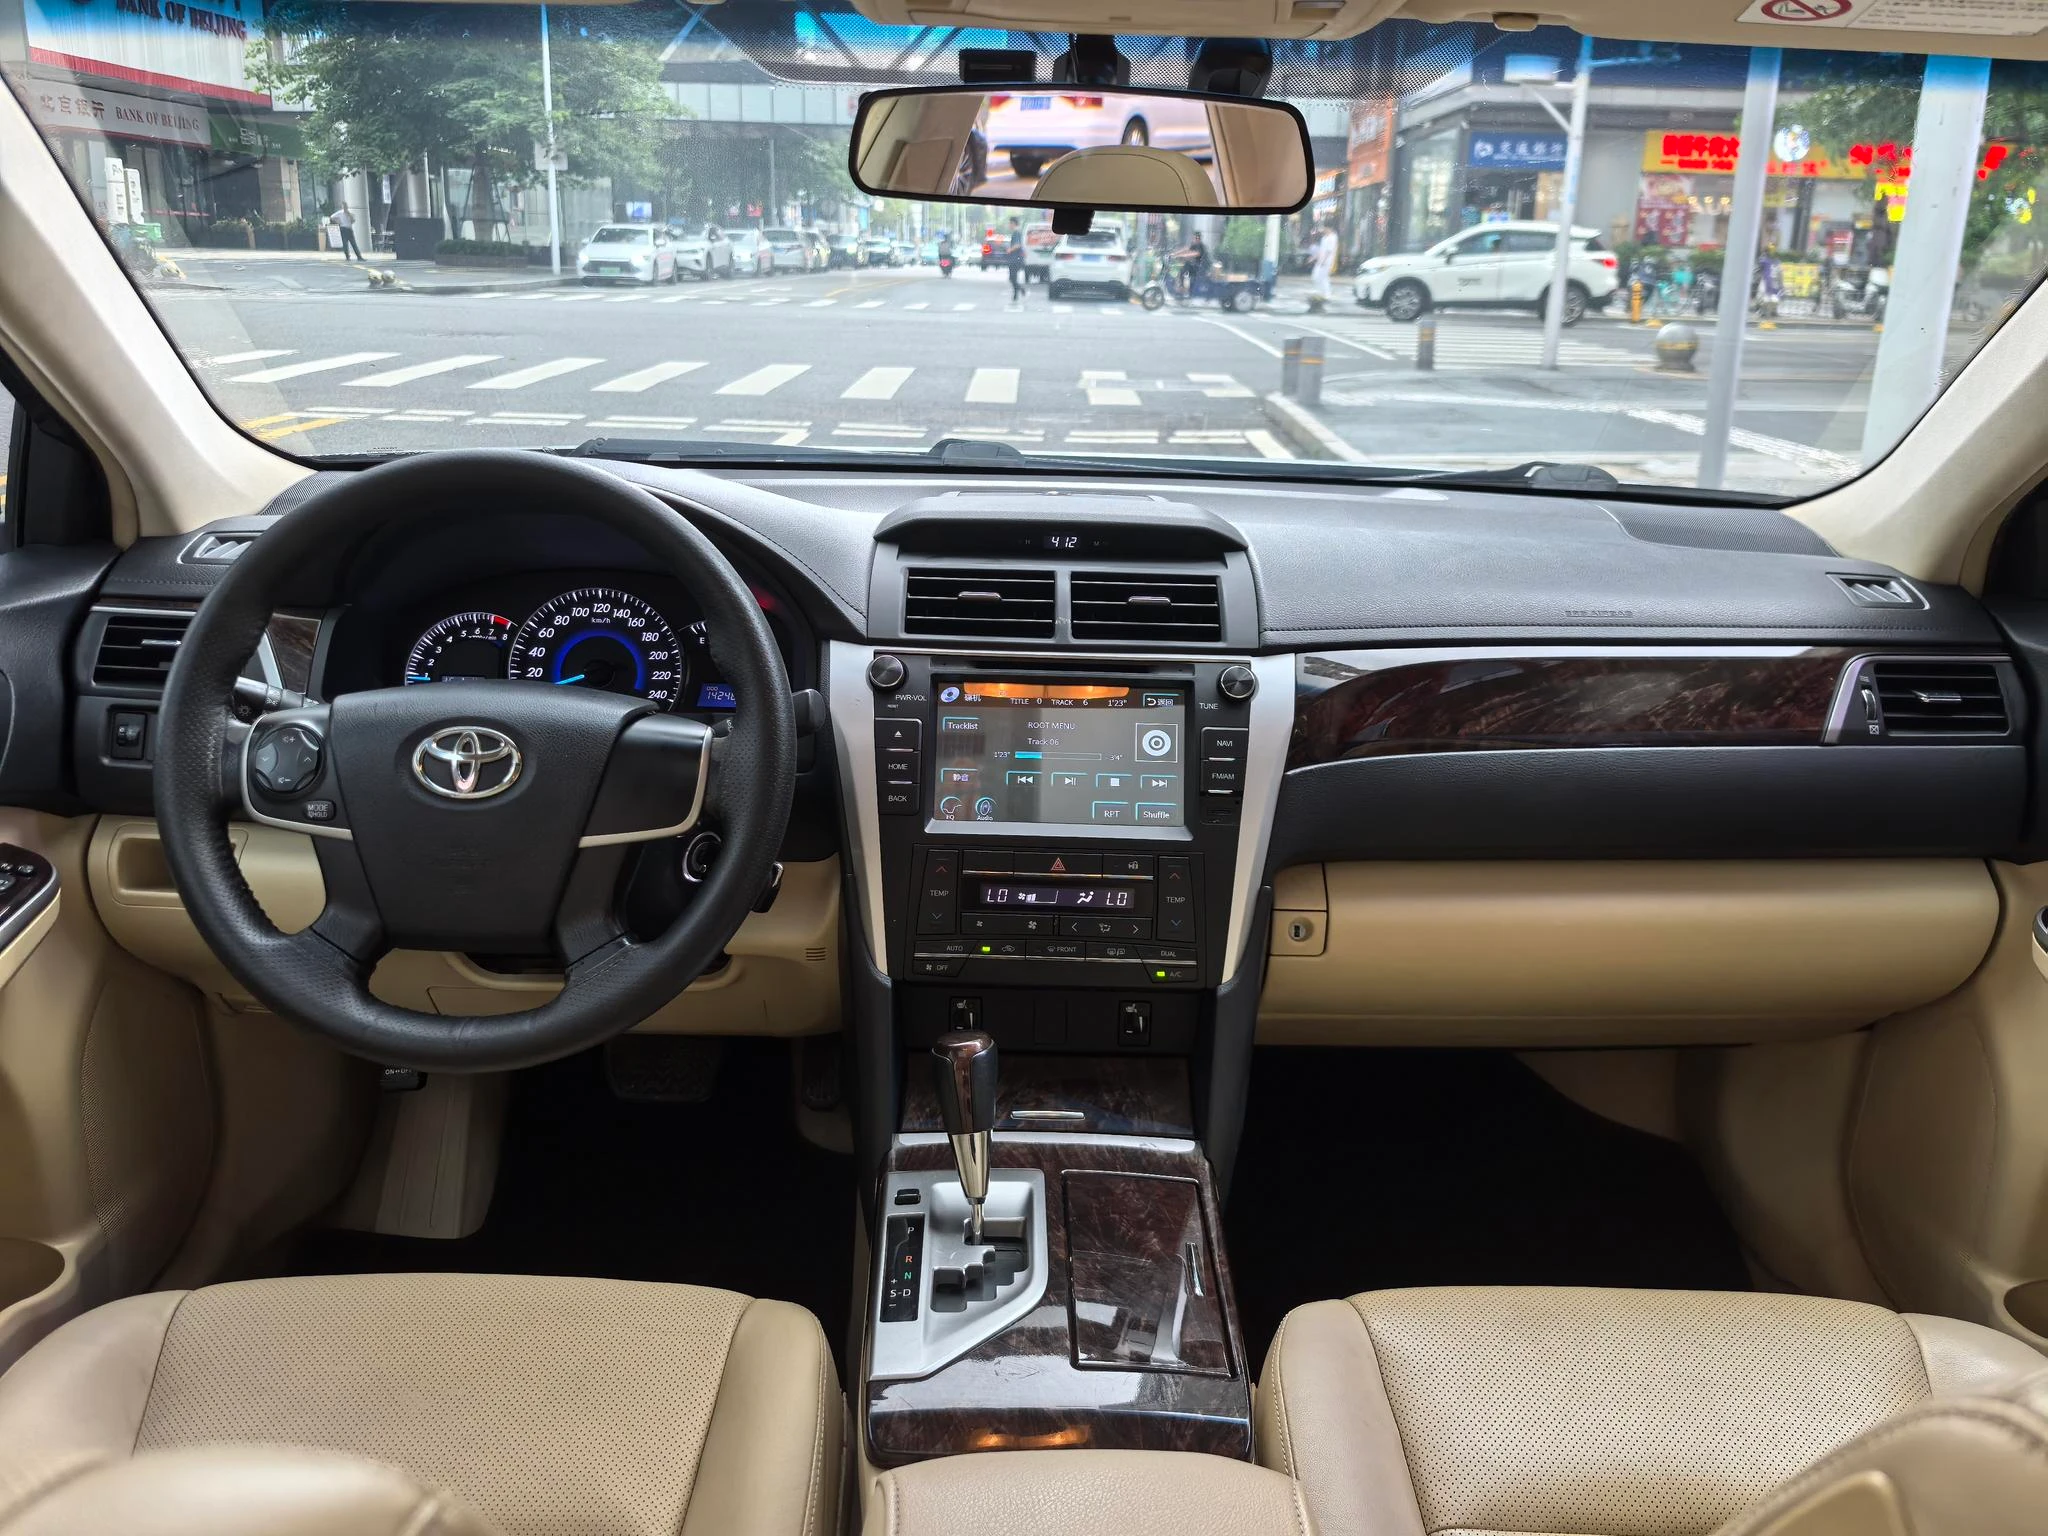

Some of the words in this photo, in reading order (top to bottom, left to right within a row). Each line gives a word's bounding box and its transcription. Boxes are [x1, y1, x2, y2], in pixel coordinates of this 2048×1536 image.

[164, 2, 184, 24] OF
[189, 6, 247, 40] BEIJING
[116, 106, 144, 122] BANK
[146, 112, 158, 124] OF
[161, 114, 200, 130] BEIJING
[572, 608, 589, 617] 100
[593, 603, 610, 613] 120
[613, 608, 630, 618] 140
[554, 616, 570, 626] 80
[628, 618, 645, 628] 160
[538, 628, 554, 638] 60
[642, 632, 659, 642] 180
[529, 647, 546, 657] 40
[648, 651, 668, 660] 200
[526, 667, 544, 678] 20
[652, 671, 671, 680] 220
[648, 690, 668, 700] 240
[948, 722, 978, 730] Tracklist
[1143, 811, 1170, 819] Shuffle
[987, 888, 1008, 902] LO
[1106, 892, 1128, 906] LO
[904, 1272, 912, 1280] N
